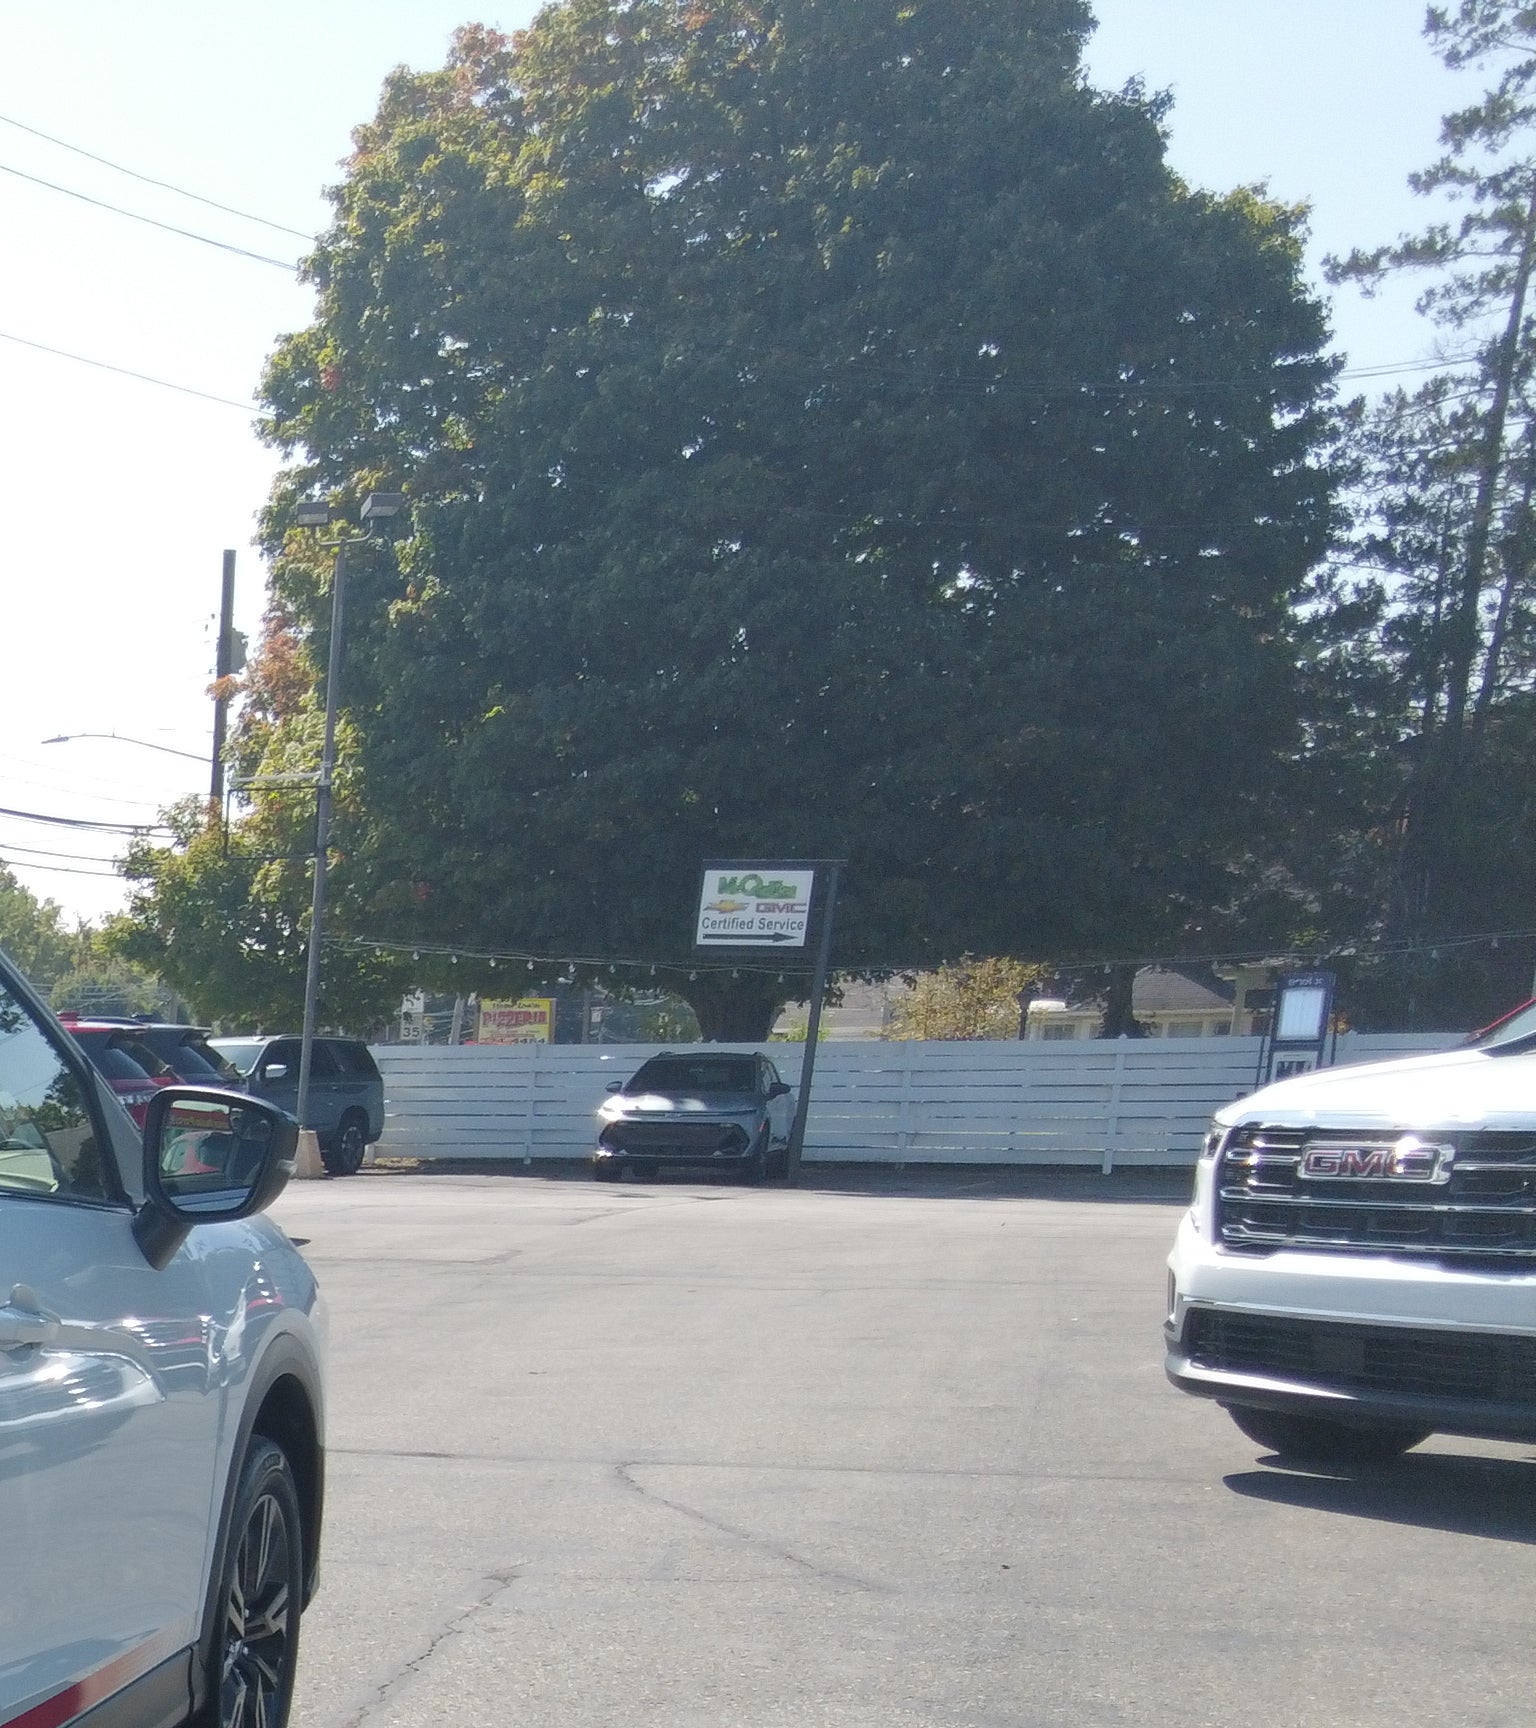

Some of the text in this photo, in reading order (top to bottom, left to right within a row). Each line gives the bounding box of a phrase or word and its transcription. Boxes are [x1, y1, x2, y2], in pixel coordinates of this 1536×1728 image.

[756, 902, 807, 913] GMC
[701, 917, 805, 931] Certified Service
[402, 1026, 421, 1038] 35
[1304, 1149, 1434, 1179] GMC
